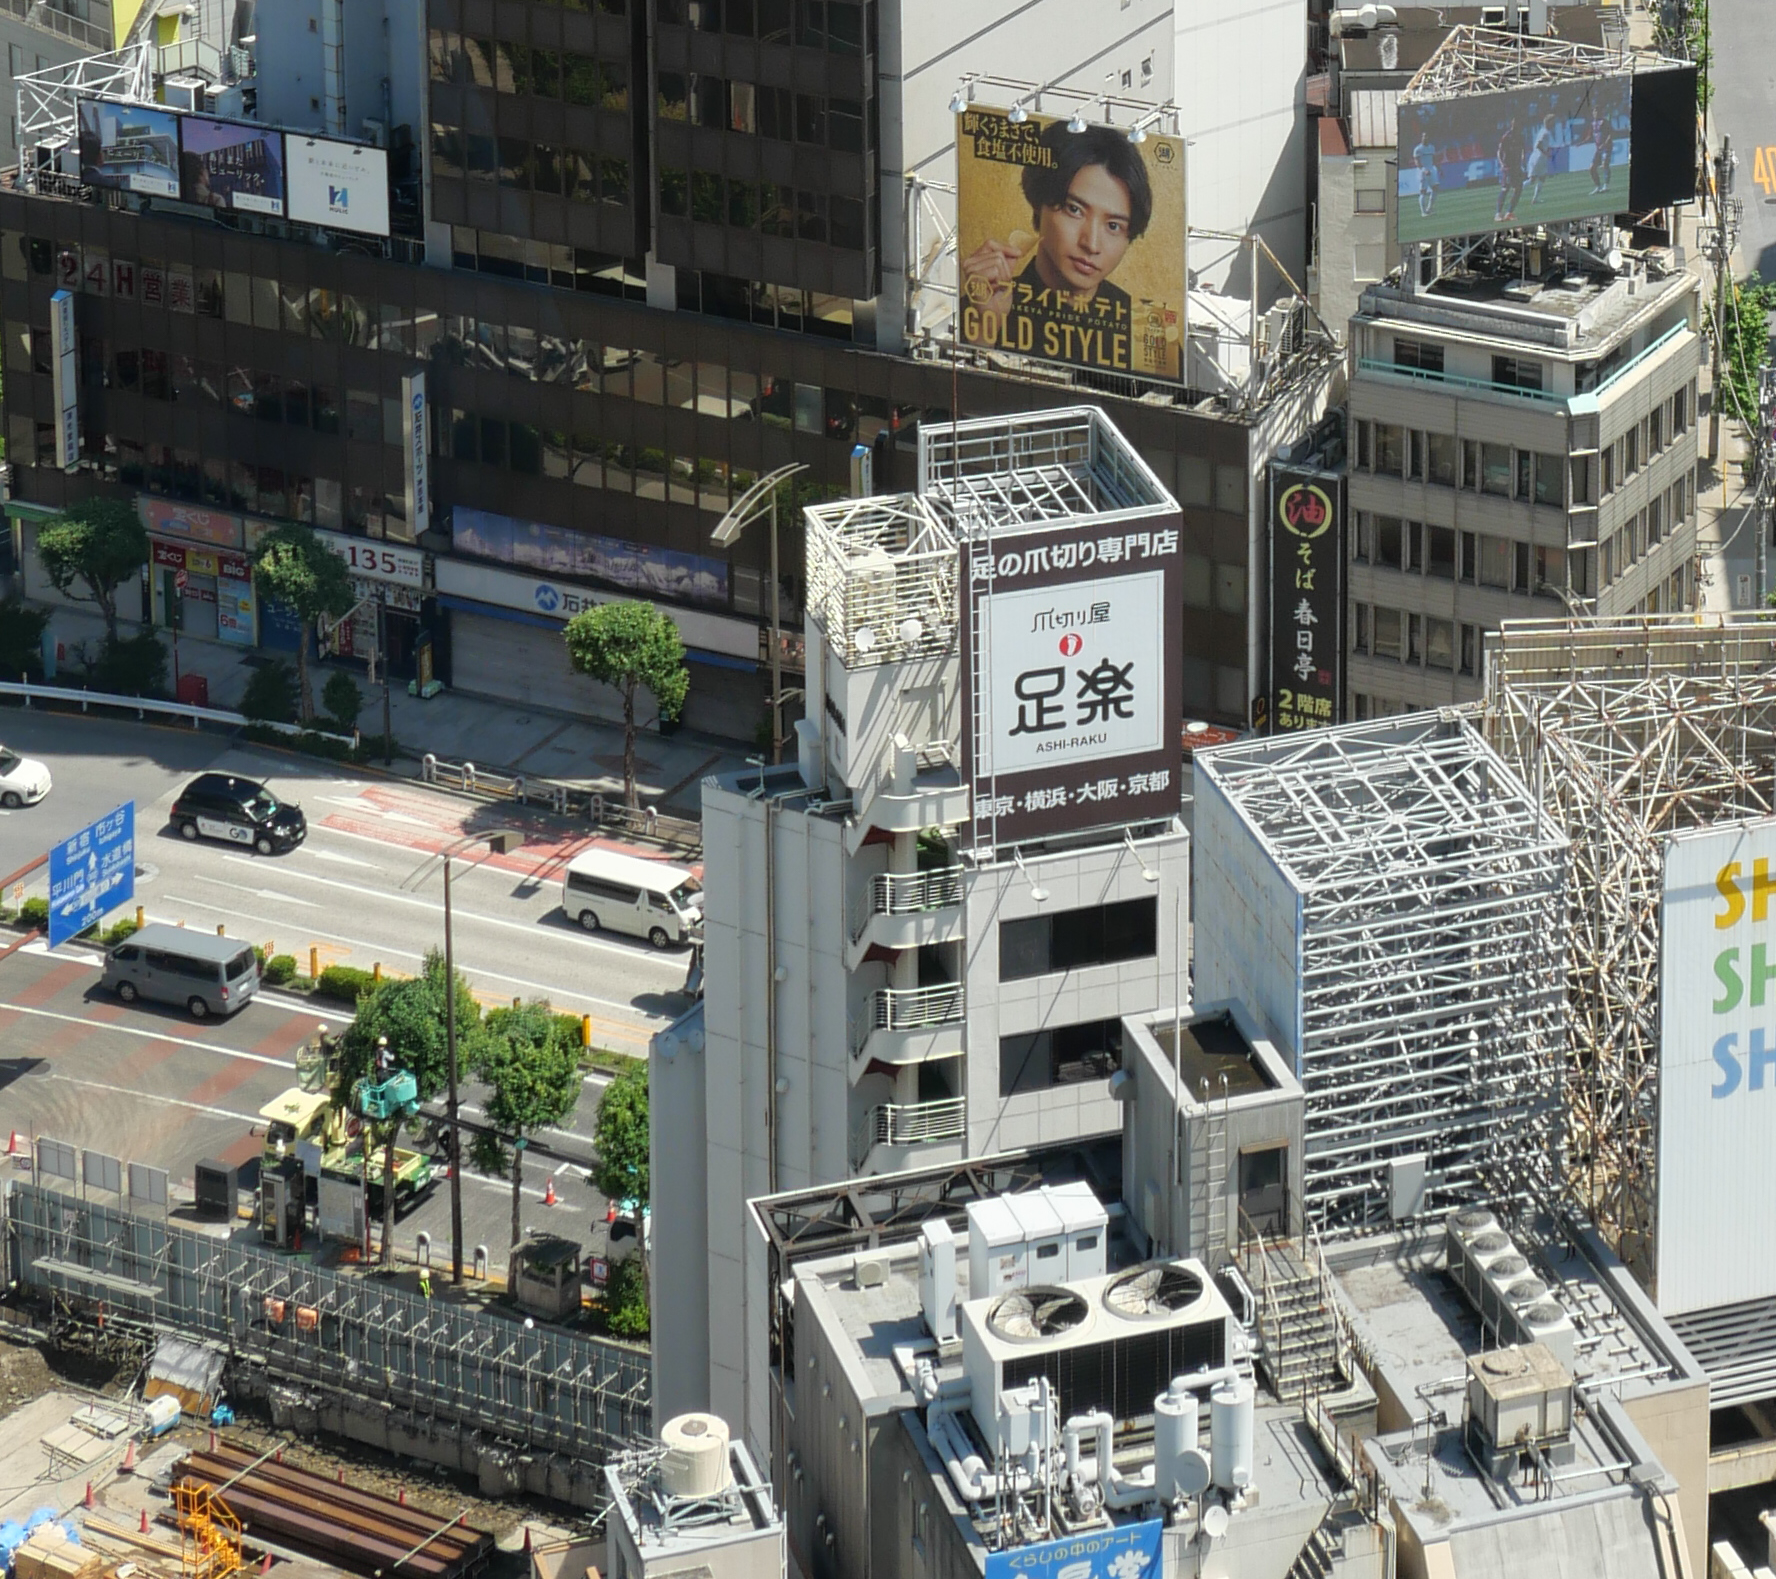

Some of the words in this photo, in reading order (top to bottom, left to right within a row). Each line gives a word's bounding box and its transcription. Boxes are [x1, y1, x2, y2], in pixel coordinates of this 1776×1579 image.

[963, 113, 1042, 143] 輝くうまさで、
[976, 137, 1059, 170] 食塩不使用。
[209, 165, 266, 185] ヒューリック。
[60, 255, 191, 307] 24H営業
[998, 280, 1128, 322] プライドポテト
[964, 306, 1034, 353] GOLD
[1043, 321, 1128, 370] STYLE
[157, 549, 183, 564] 宝くじ
[348, 545, 396, 575] 135
[971, 529, 1180, 583] 足の爪切り専門店
[1031, 601, 1111, 633] 爪切り屋
[1293, 597, 1319, 682] 春日亭
[1008, 657, 1135, 737] 足楽
[1279, 688, 1332, 718] 2階席
[1035, 733, 1108, 754] ASHI-RAKU
[973, 770, 1171, 820] 東京・横浜・大阪・京都
[66, 831, 90, 855] 新宿
[101, 840, 133, 870] 水道橋
[52, 869, 85, 899] 平川門
[80, 907, 105, 928] 200m
[1009, 1531, 1142, 1569] くらしの中のアート
